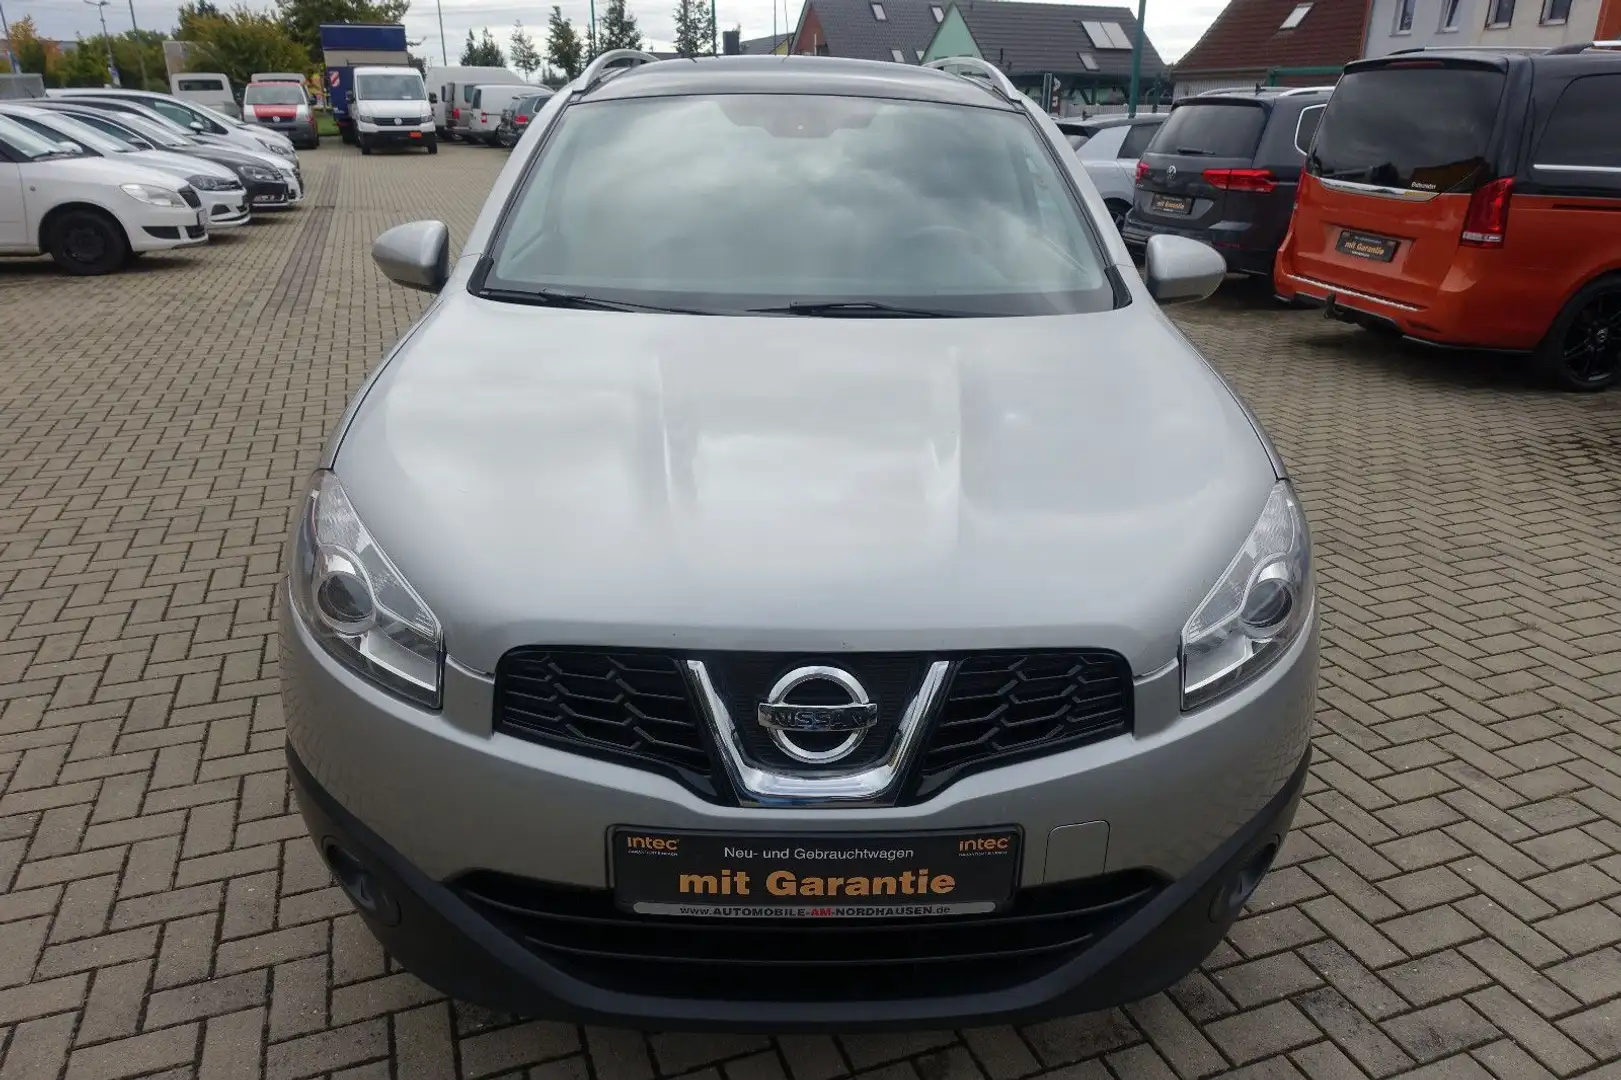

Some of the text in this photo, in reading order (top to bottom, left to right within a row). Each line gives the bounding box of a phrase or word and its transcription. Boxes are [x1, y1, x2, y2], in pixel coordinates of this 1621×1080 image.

[1356, 243, 1385, 256] Garantie
[770, 710, 863, 727] NISSAN
[627, 836, 679, 851] intec
[959, 836, 1010, 851] intec
[724, 847, 914, 861] Neu- und Gebrauchtwagen
[679, 867, 956, 897] mit Garantie
[680, 906, 951, 918] www.AUTOMOBILE-AM-NORDHAUSEN.de
